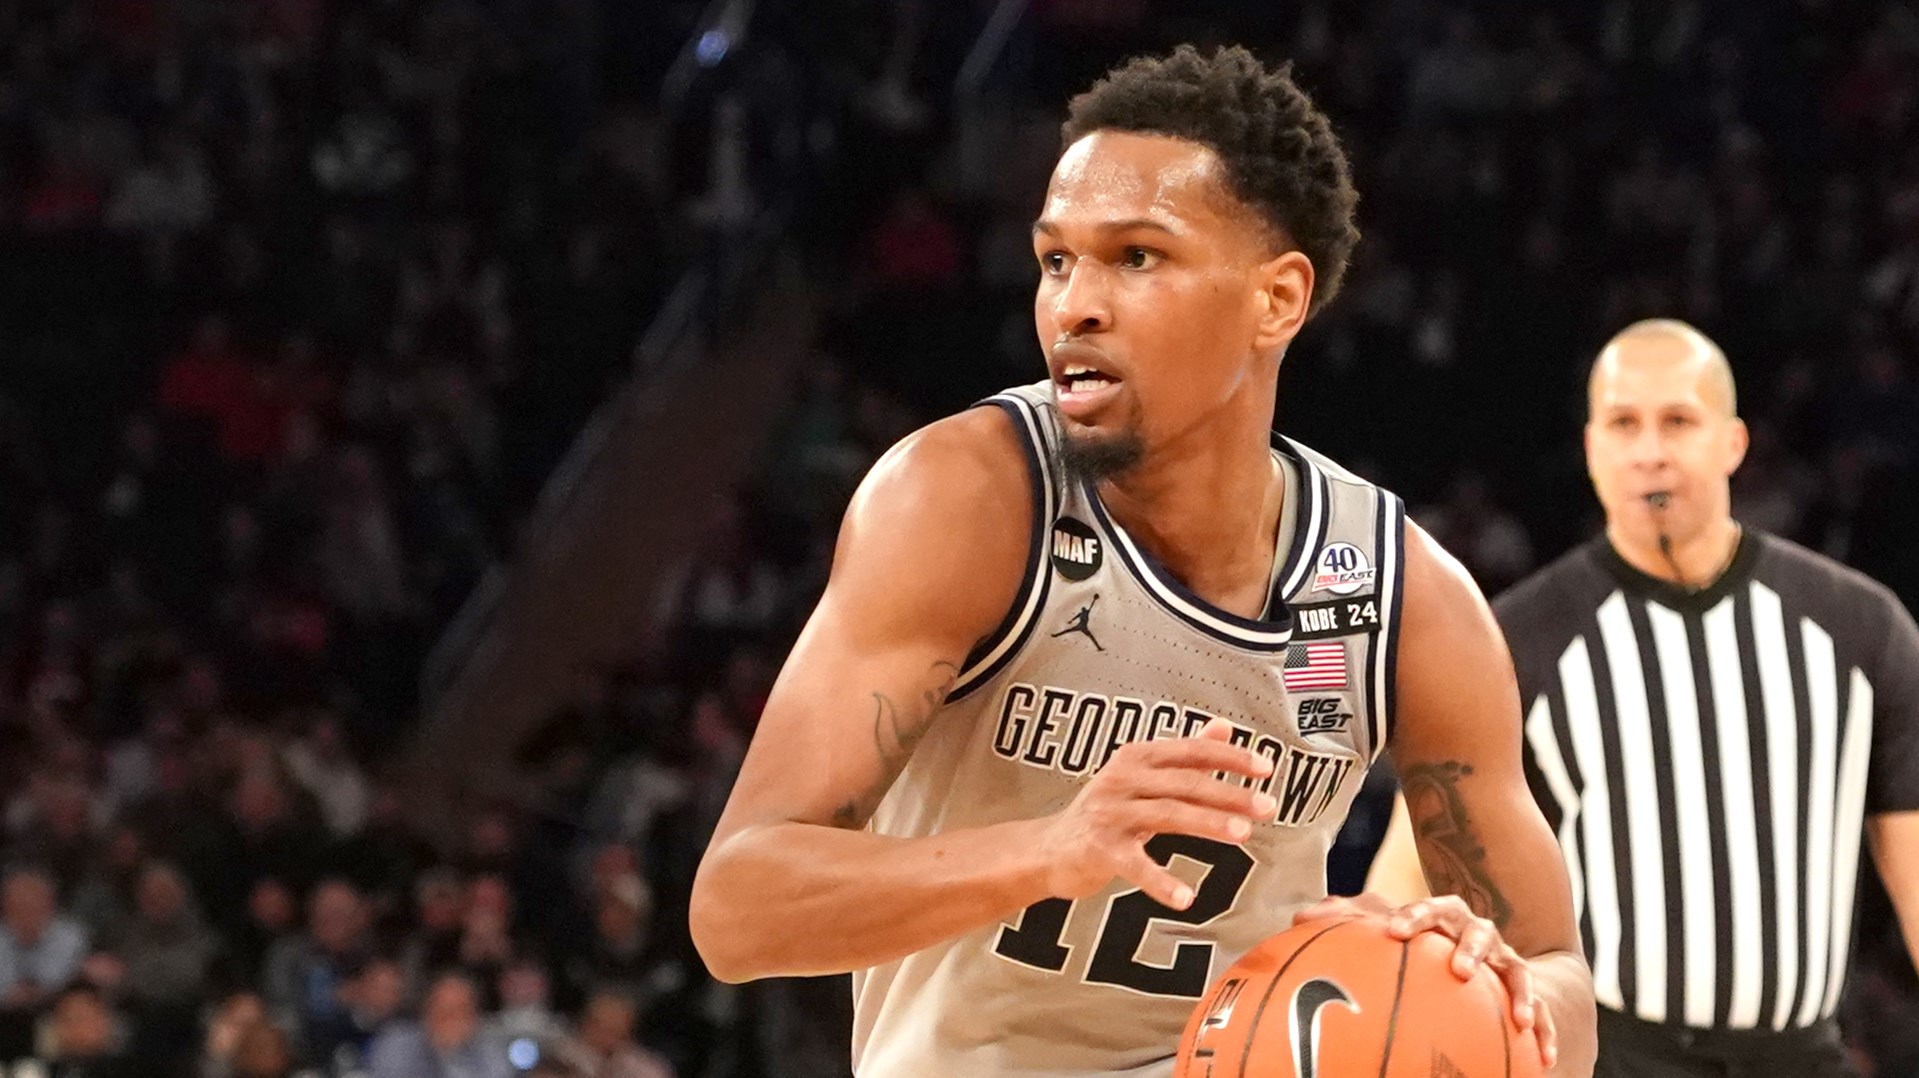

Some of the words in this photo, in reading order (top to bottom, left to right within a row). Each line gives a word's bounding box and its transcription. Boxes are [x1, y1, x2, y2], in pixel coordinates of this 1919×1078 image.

[1053, 530, 1098, 565] MAF
[1323, 547, 1358, 573] 40
[1317, 574, 1338, 583] BIG
[1339, 570, 1373, 582] EAST
[1298, 606, 1339, 633] KOBE
[1347, 600, 1378, 627] 24
[1298, 697, 1341, 715] BIG
[1298, 713, 1354, 730] EAST
